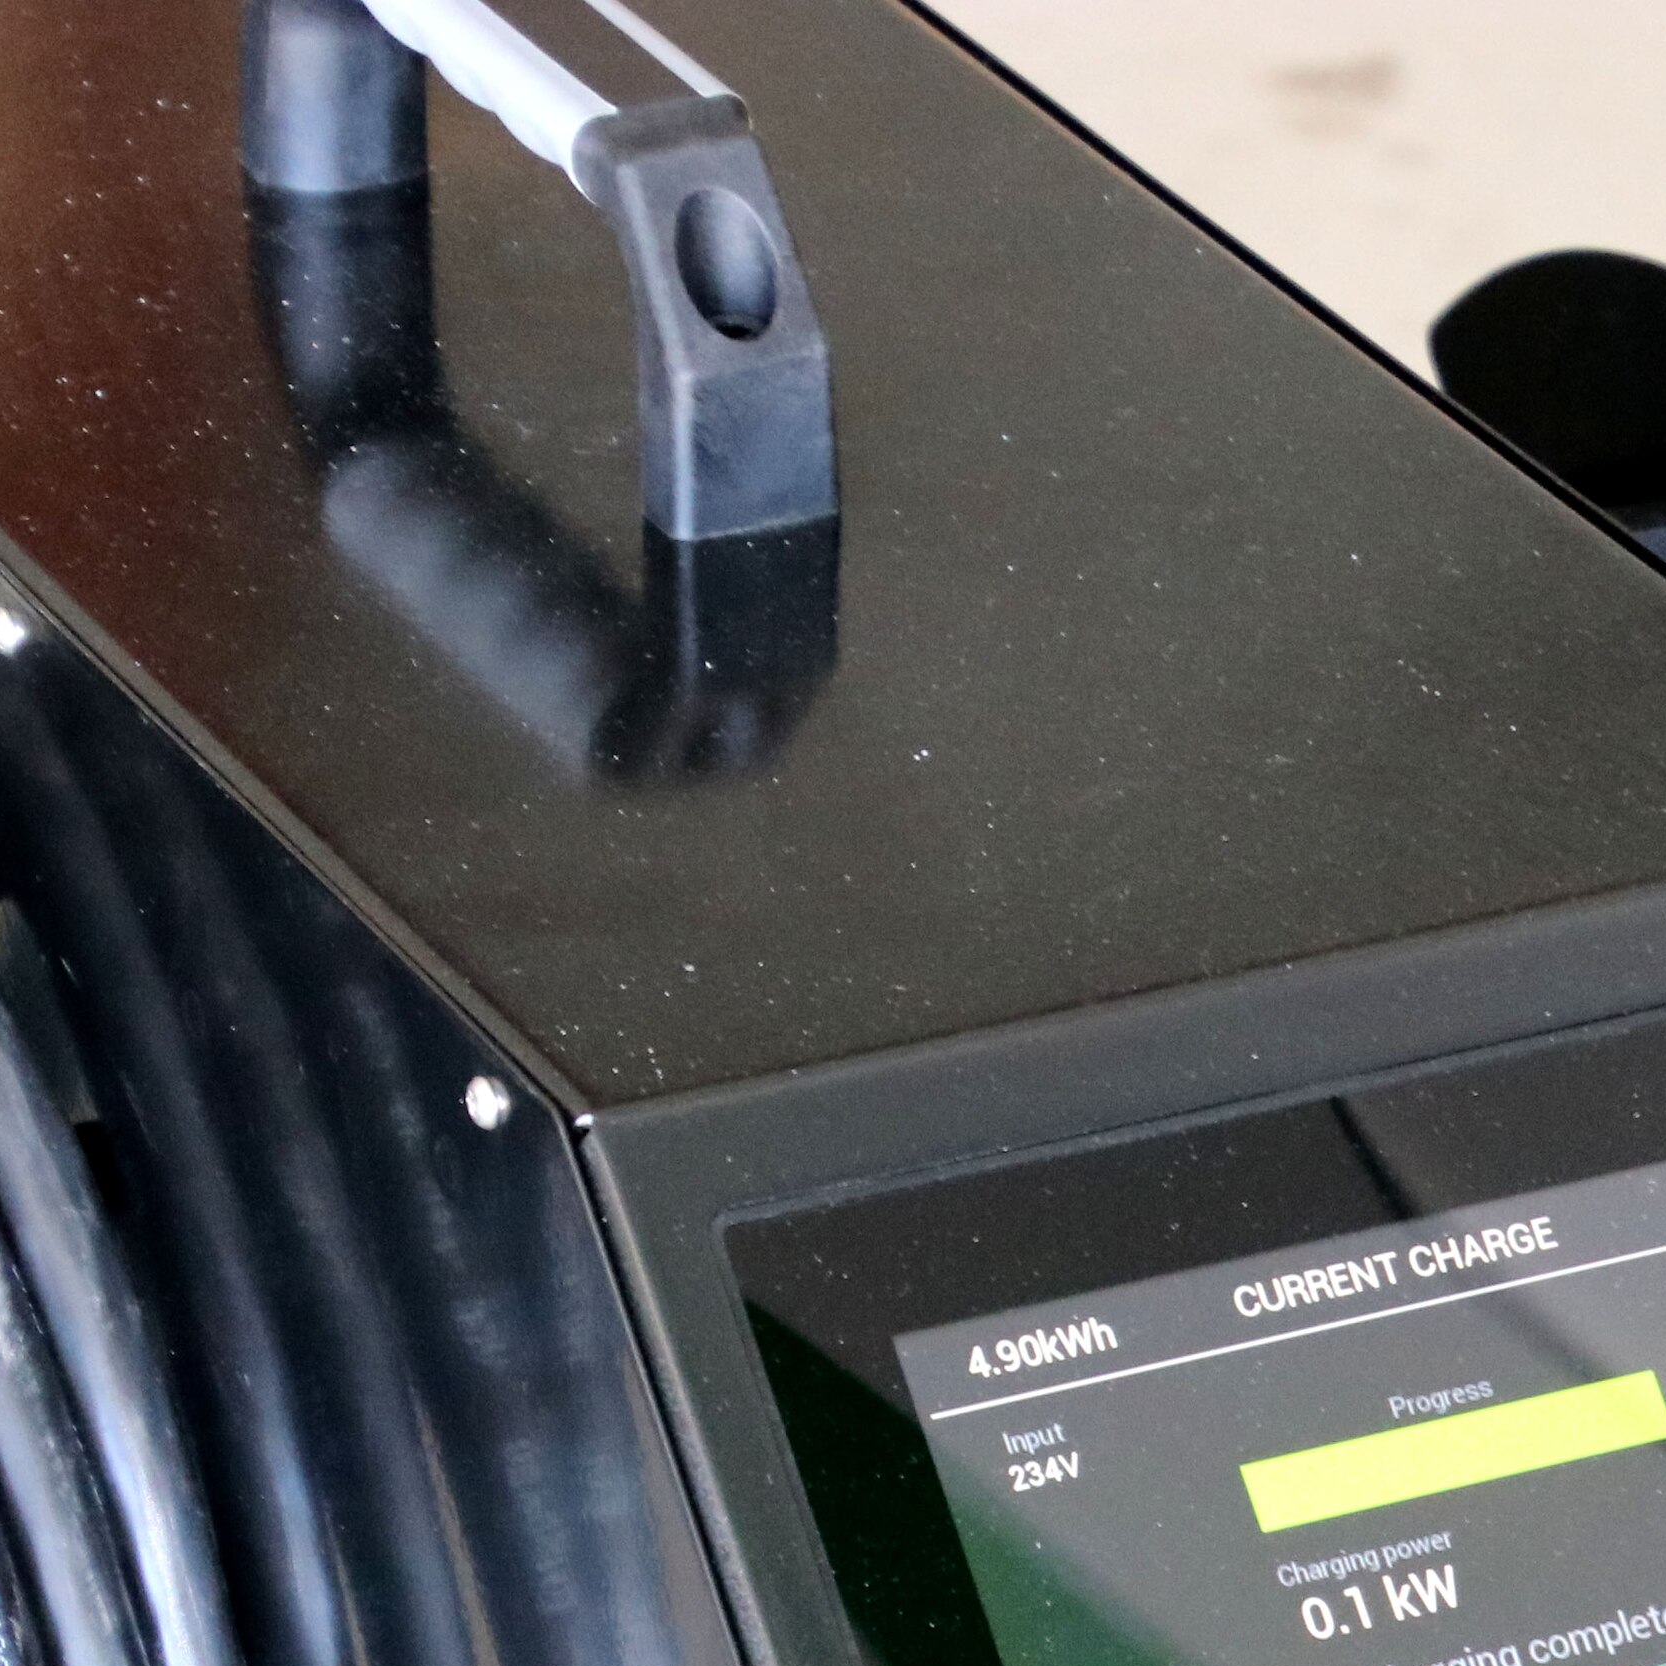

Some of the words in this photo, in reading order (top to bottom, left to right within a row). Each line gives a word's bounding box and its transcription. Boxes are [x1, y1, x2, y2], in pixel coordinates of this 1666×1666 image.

[1233, 1252, 1397, 1318] CURRENT
[1408, 1216, 1559, 1278] CHARGE
[967, 1316, 1119, 1379] 4.90kWh
[1387, 1379, 1494, 1420] Progress
[1001, 1422, 1068, 1456] Input
[1008, 1451, 1080, 1493] 234V
[1276, 1546, 1382, 1588] Charging
[1386, 1530, 1453, 1566] power
[1300, 1586, 1374, 1642] 0.1
[1381, 1563, 1459, 1623] kW
